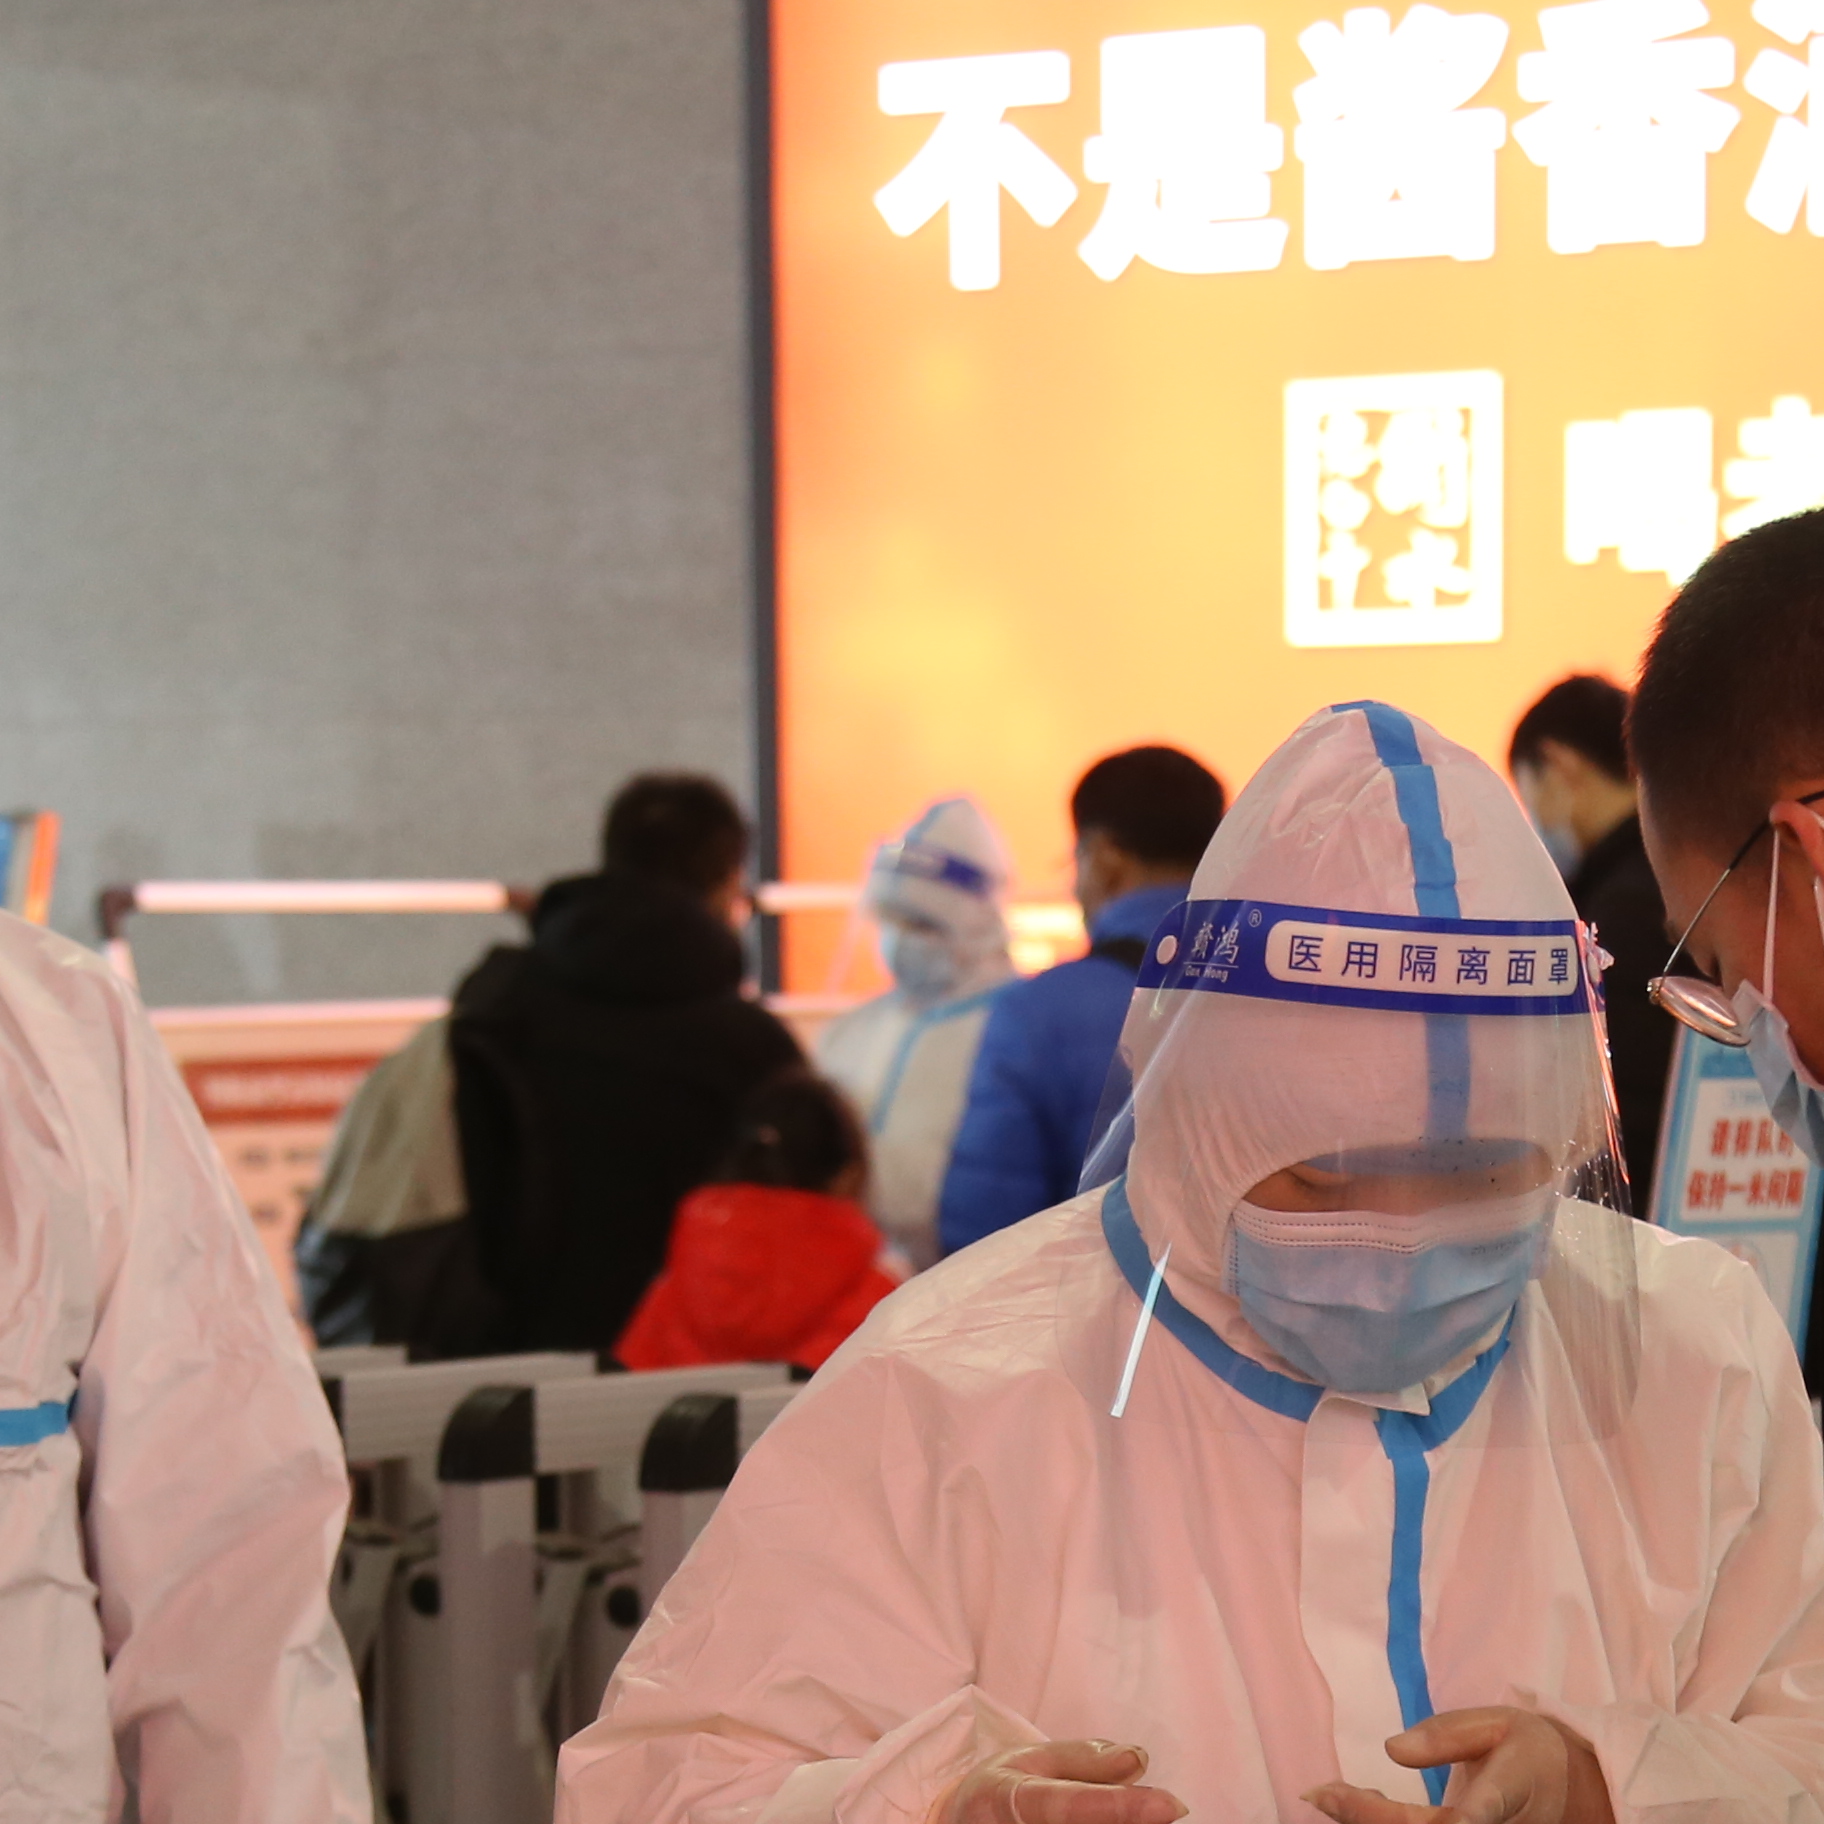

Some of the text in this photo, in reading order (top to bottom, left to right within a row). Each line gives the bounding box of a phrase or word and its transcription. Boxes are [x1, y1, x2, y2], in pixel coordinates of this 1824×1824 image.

[1287, 934, 1569, 986] 医用隔离面罩
